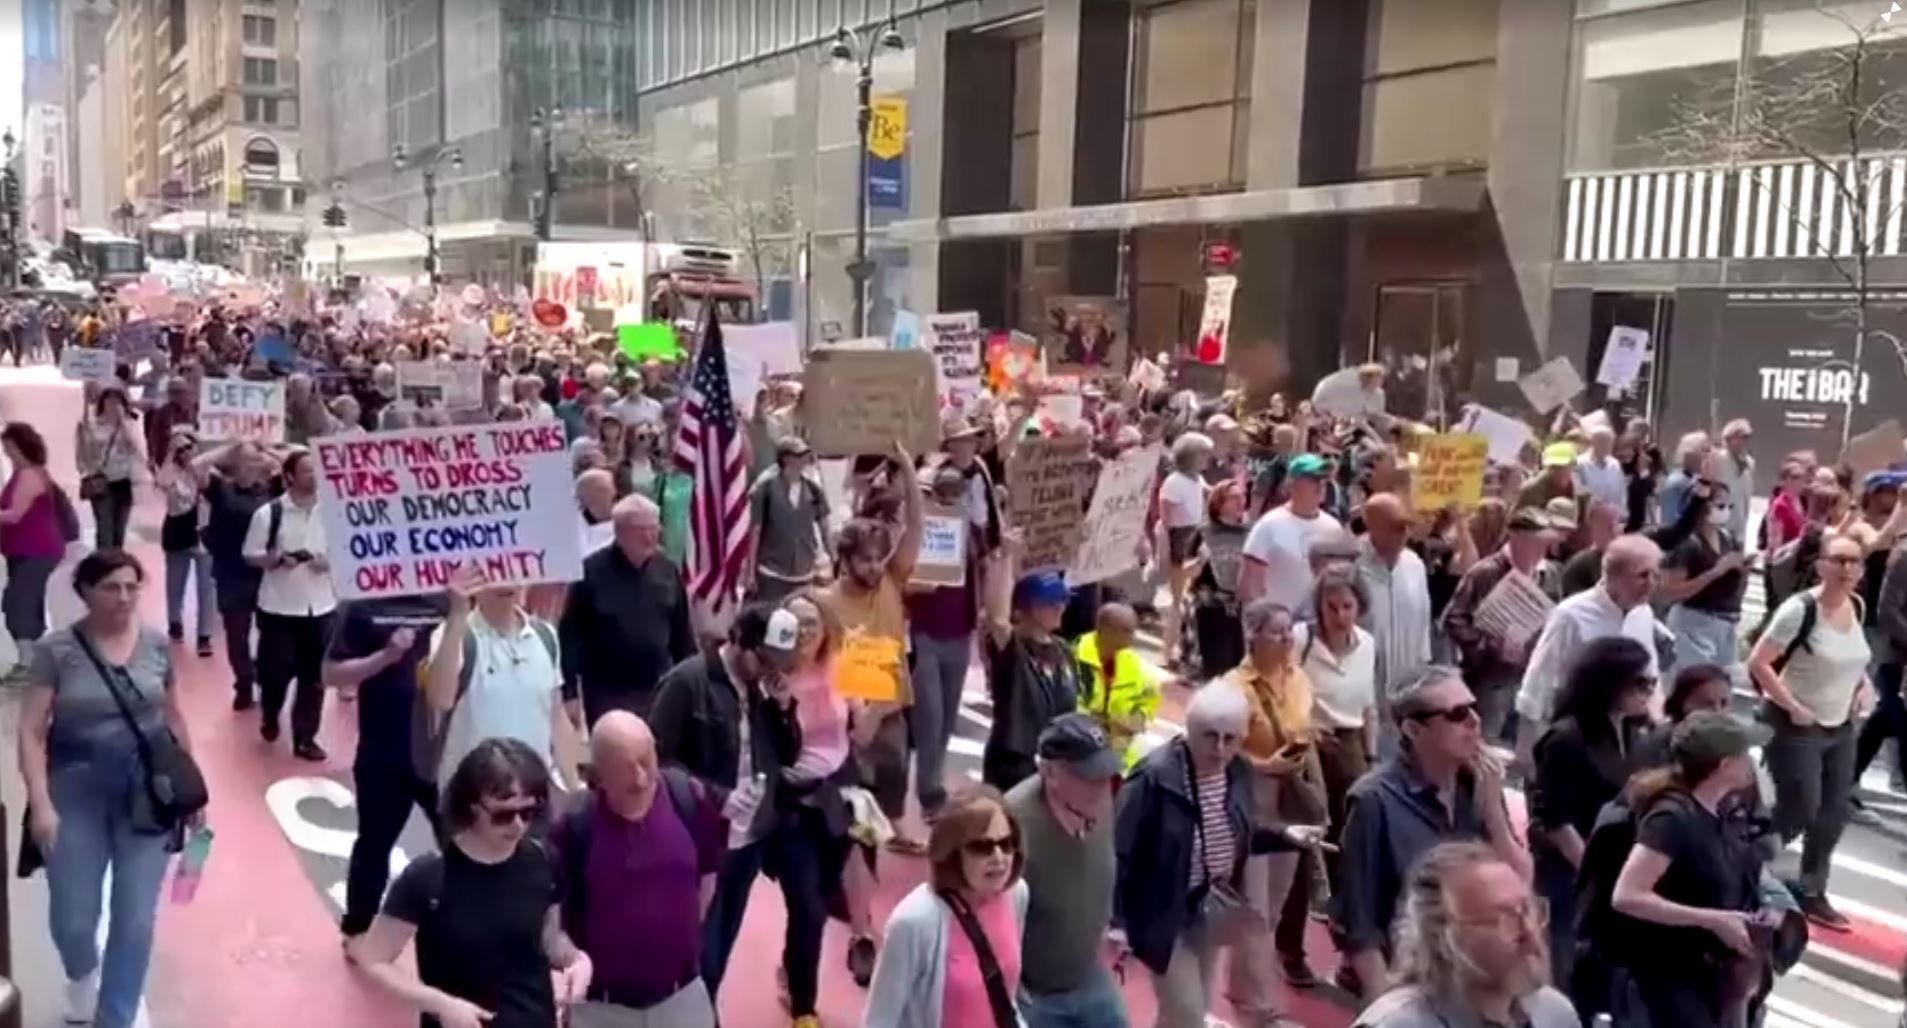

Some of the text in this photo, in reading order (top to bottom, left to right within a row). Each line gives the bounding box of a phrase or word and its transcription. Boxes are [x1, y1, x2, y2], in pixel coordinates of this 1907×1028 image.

[872, 114, 900, 141] Be
[209, 384, 277, 408] DEFY
[201, 412, 280, 435] TRUMP
[318, 425, 565, 470] EVERYTHING HE TOUCHES
[326, 460, 522, 499] TURNS TO DROSS
[346, 484, 532, 527] OUR DEMOCRACY
[350, 519, 519, 560] OUR ECONOMY
[356, 563, 404, 592] OUR
